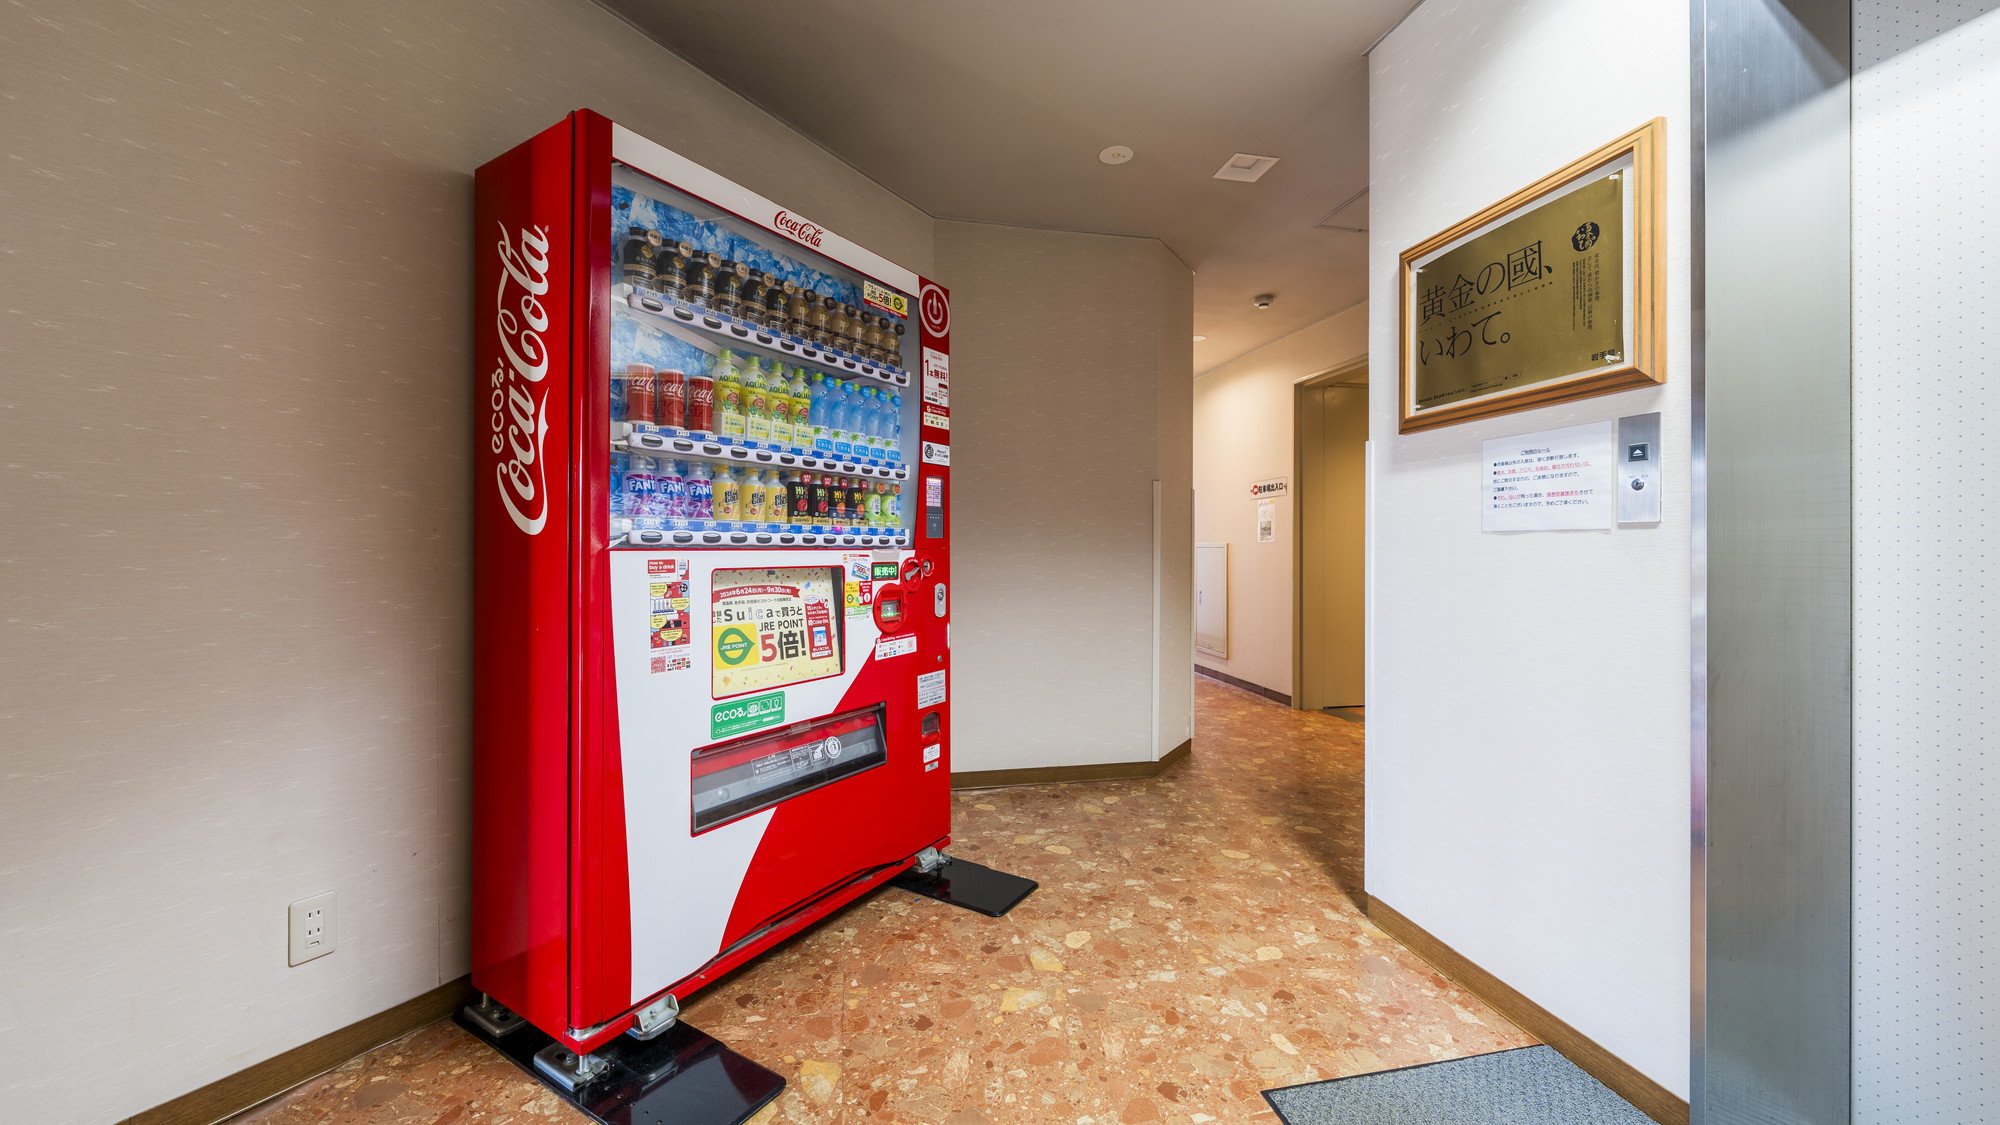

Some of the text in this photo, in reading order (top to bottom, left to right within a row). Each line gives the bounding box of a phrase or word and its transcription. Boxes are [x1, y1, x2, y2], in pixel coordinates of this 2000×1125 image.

[774, 210, 823, 248] Coca-Cola
[1420, 311, 1511, 366] いわて。
[497, 220, 549, 535] Coca-Cola
[759, 619, 804, 632] JRE POINT
[720, 643, 731, 651] JRE
